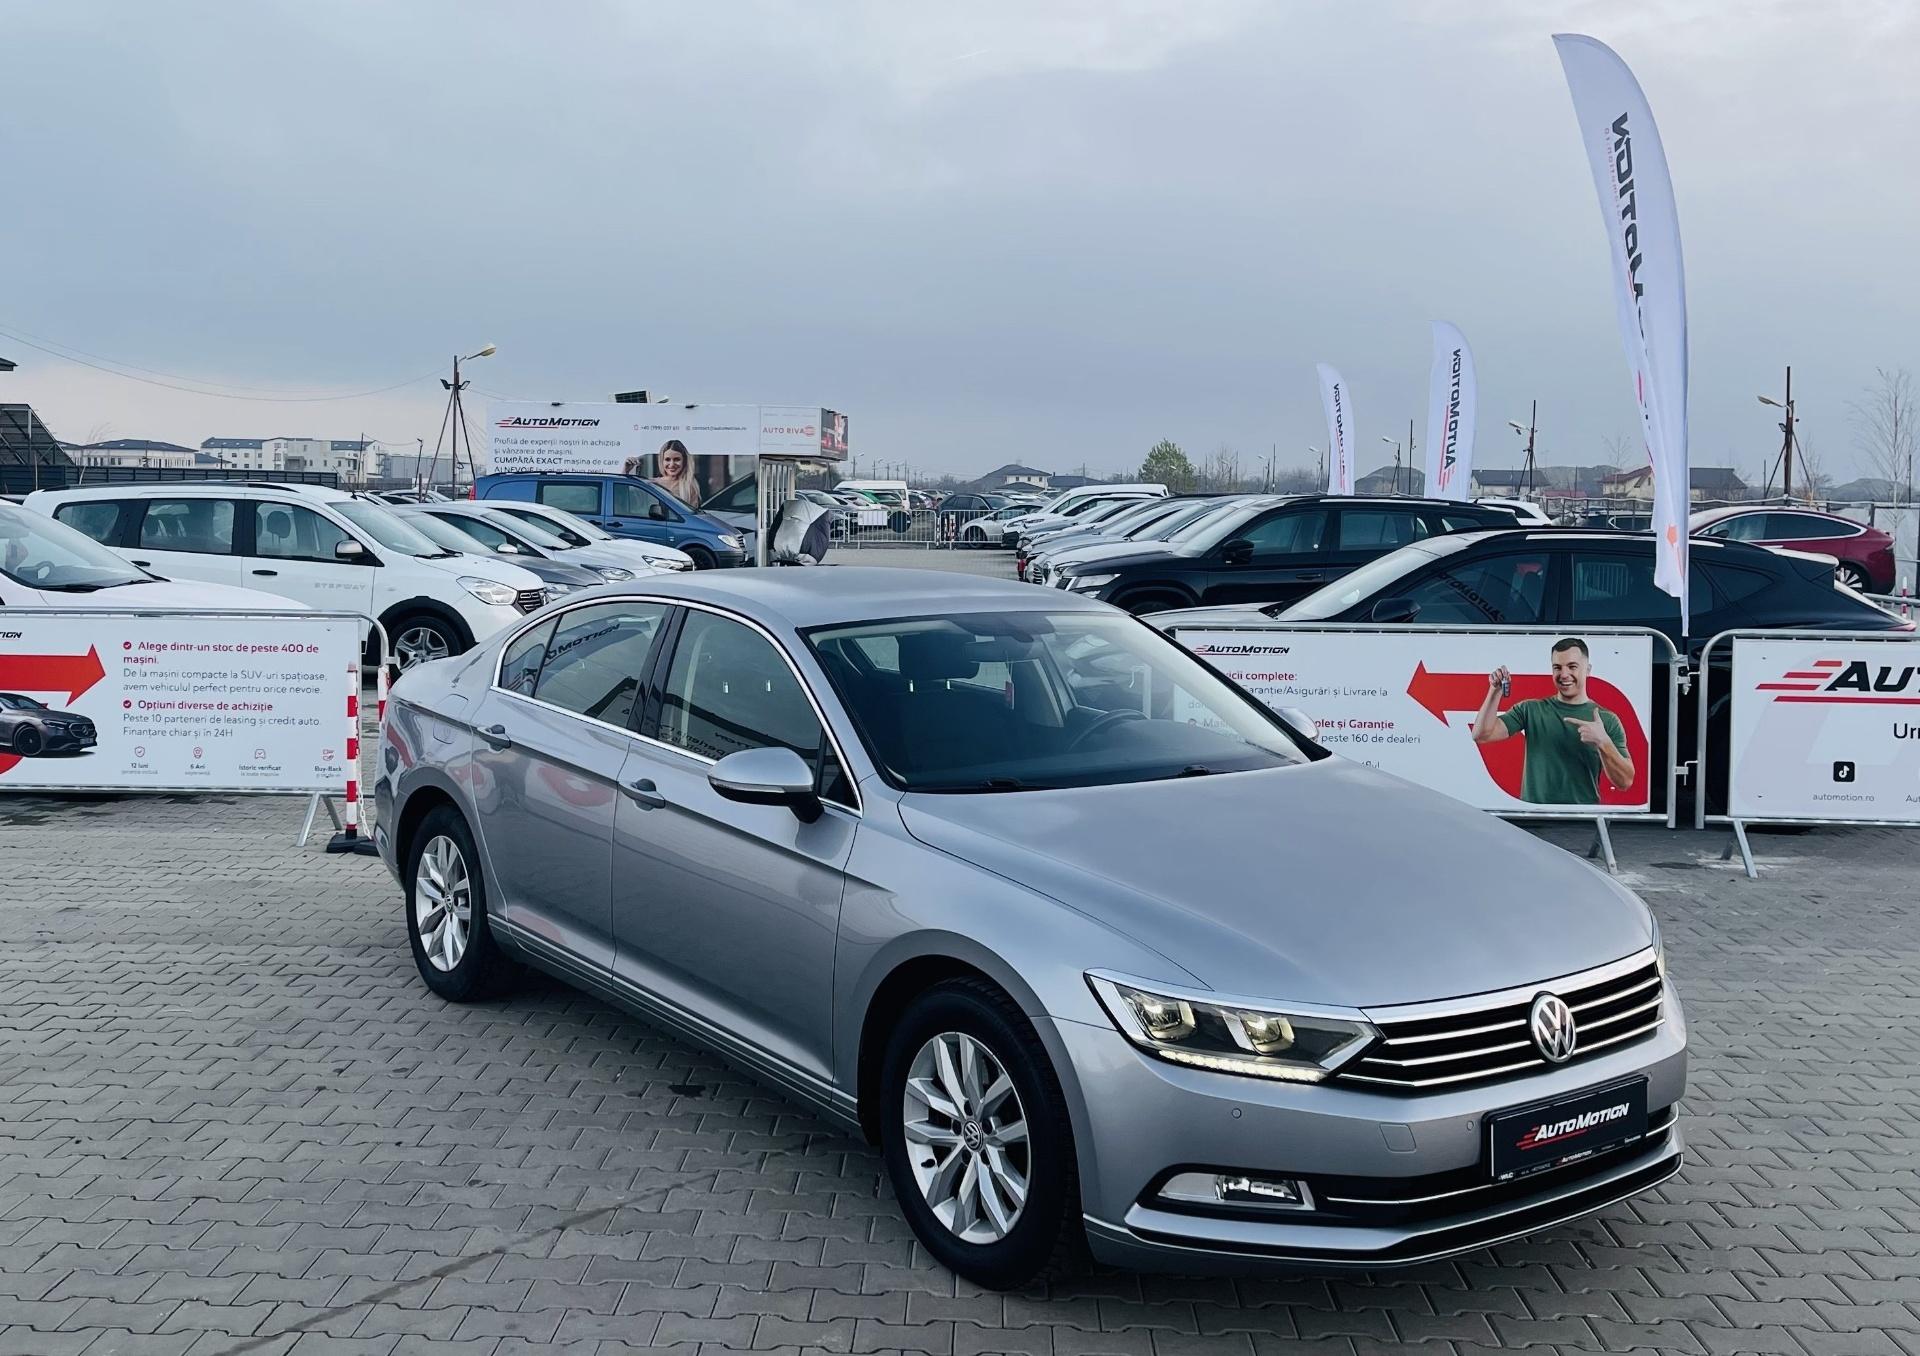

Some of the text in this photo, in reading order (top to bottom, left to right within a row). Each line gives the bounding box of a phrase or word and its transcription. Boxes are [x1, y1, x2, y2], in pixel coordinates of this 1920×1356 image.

[138, 642, 319, 654] Alege dintr-un stoc de peste 400 de
[1207, 645, 1290, 654] AUTOMOTION
[123, 656, 159, 666] mașini.
[123, 668, 137, 678] De
[140, 669, 147, 677] la
[150, 669, 179, 679] mașini
[182, 670, 228, 680] compacte
[230, 670, 238, 678] la
[1246, 673, 1297, 682] complete:
[151, 682, 190, 691] vehiculul
[193, 684, 226, 693] perfect
[229, 684, 261, 693] pentru
[264, 685, 287, 693] orice
[1334, 688, 1341, 697] și
[1344, 688, 1376, 696] Livrare
[1380, 688, 1388, 696] la
[138, 701, 272, 713] Opțiuni diverse de achiziție
[123, 714, 149, 722] Peste
[164, 715, 206, 725] parteneri
[209, 715, 221, 724] de
[224, 716, 256, 726] leasing
[269, 716, 295, 725] credit
[1337, 720, 1346, 730] și
[1349, 720, 1394, 731] Garanție
[123, 727, 166, 737] Finanțare
[169, 728, 191, 737] chiar
[194, 728, 200, 739] și
[214, 729, 233, 737] 24H
[1322, 735, 1349, 744] peste
[1371, 735, 1384, 743] de
[1387, 735, 1420, 744] dealeri
[1813, 793, 1875, 802] automotion.ro
[1534, 1102, 1630, 1142] AUTOMOTION
